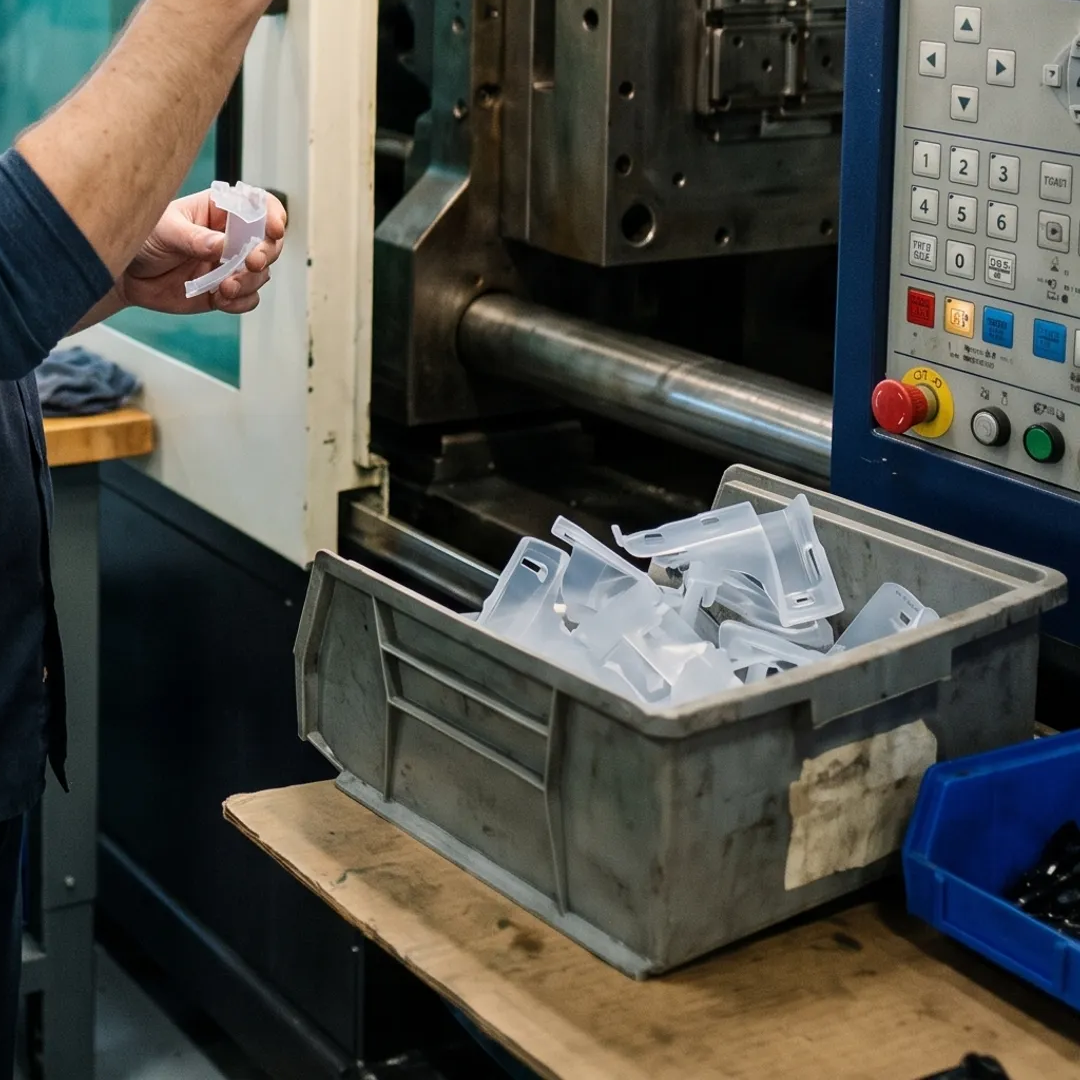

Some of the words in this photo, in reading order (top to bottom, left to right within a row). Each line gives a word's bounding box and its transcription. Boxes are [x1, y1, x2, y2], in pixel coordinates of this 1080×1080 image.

[923, 153, 929, 168] 1
[958, 159, 969, 176] 2
[998, 166, 1008, 183] 3
[919, 199, 929, 214] 4
[957, 206, 966, 222] 5
[996, 214, 1007, 231] 6
[955, 253, 964, 269] 0
